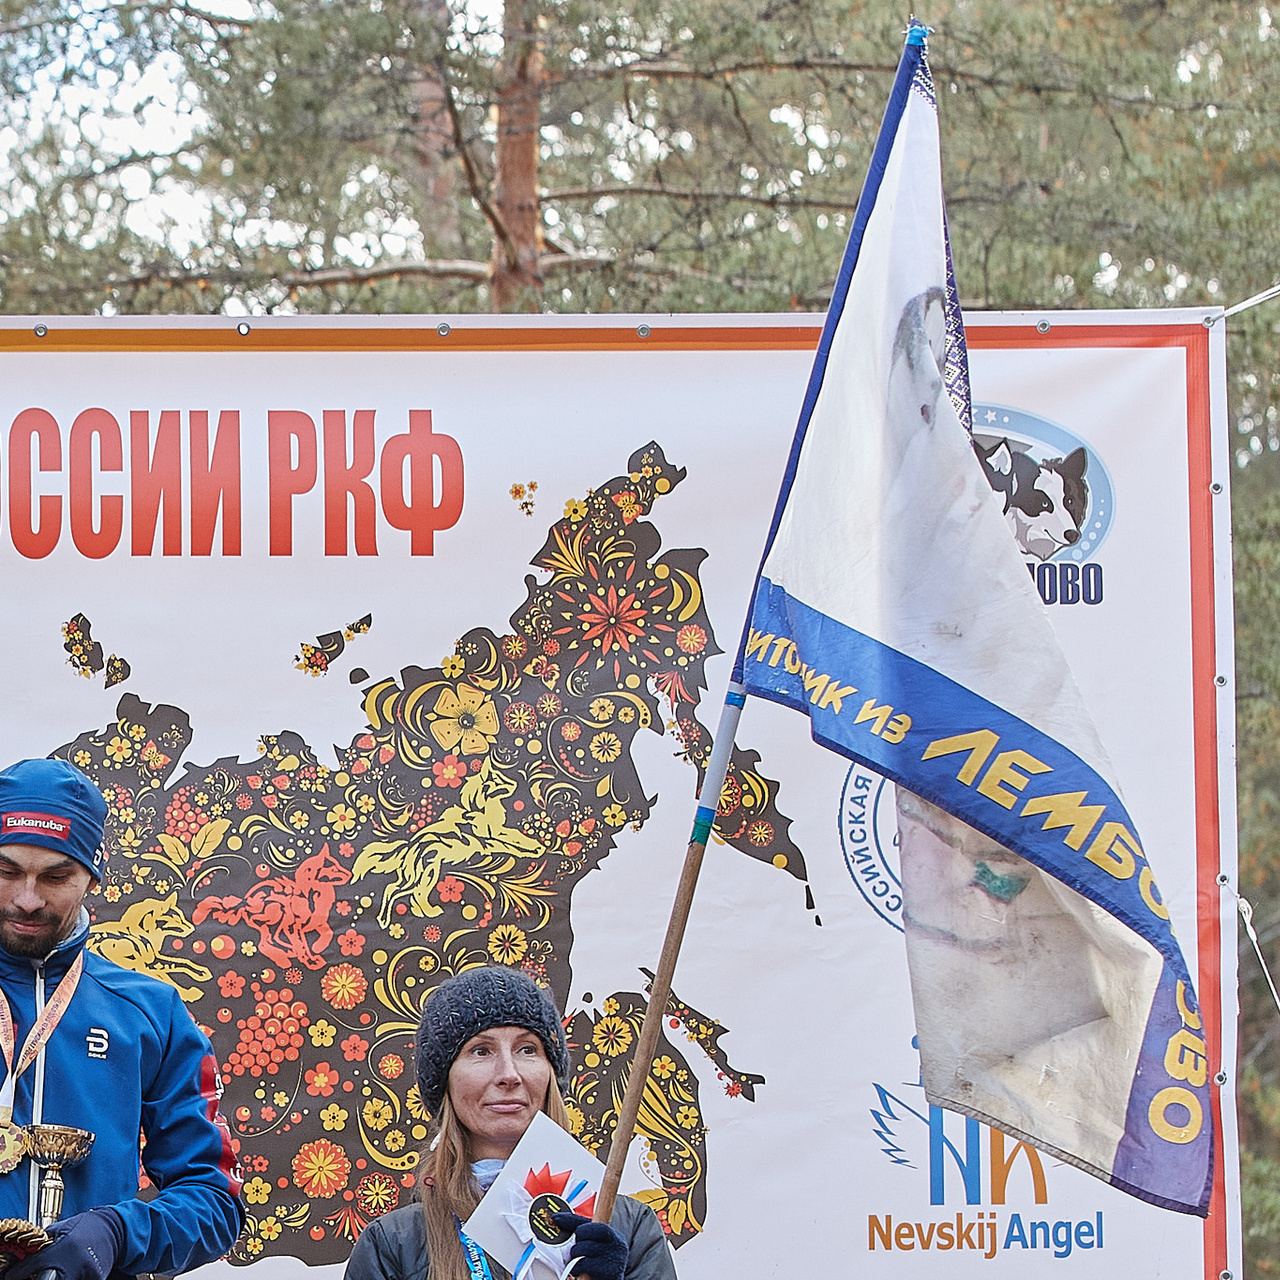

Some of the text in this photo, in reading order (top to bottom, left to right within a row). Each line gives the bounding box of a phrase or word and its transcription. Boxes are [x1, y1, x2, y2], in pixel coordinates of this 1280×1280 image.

[267, 409, 465, 557] РКФ
[1026, 563, 1103, 605] ОВО
[6, 816, 66, 832] Eukanuba
[868, 1211, 1104, 1259] Nevskij Angel
